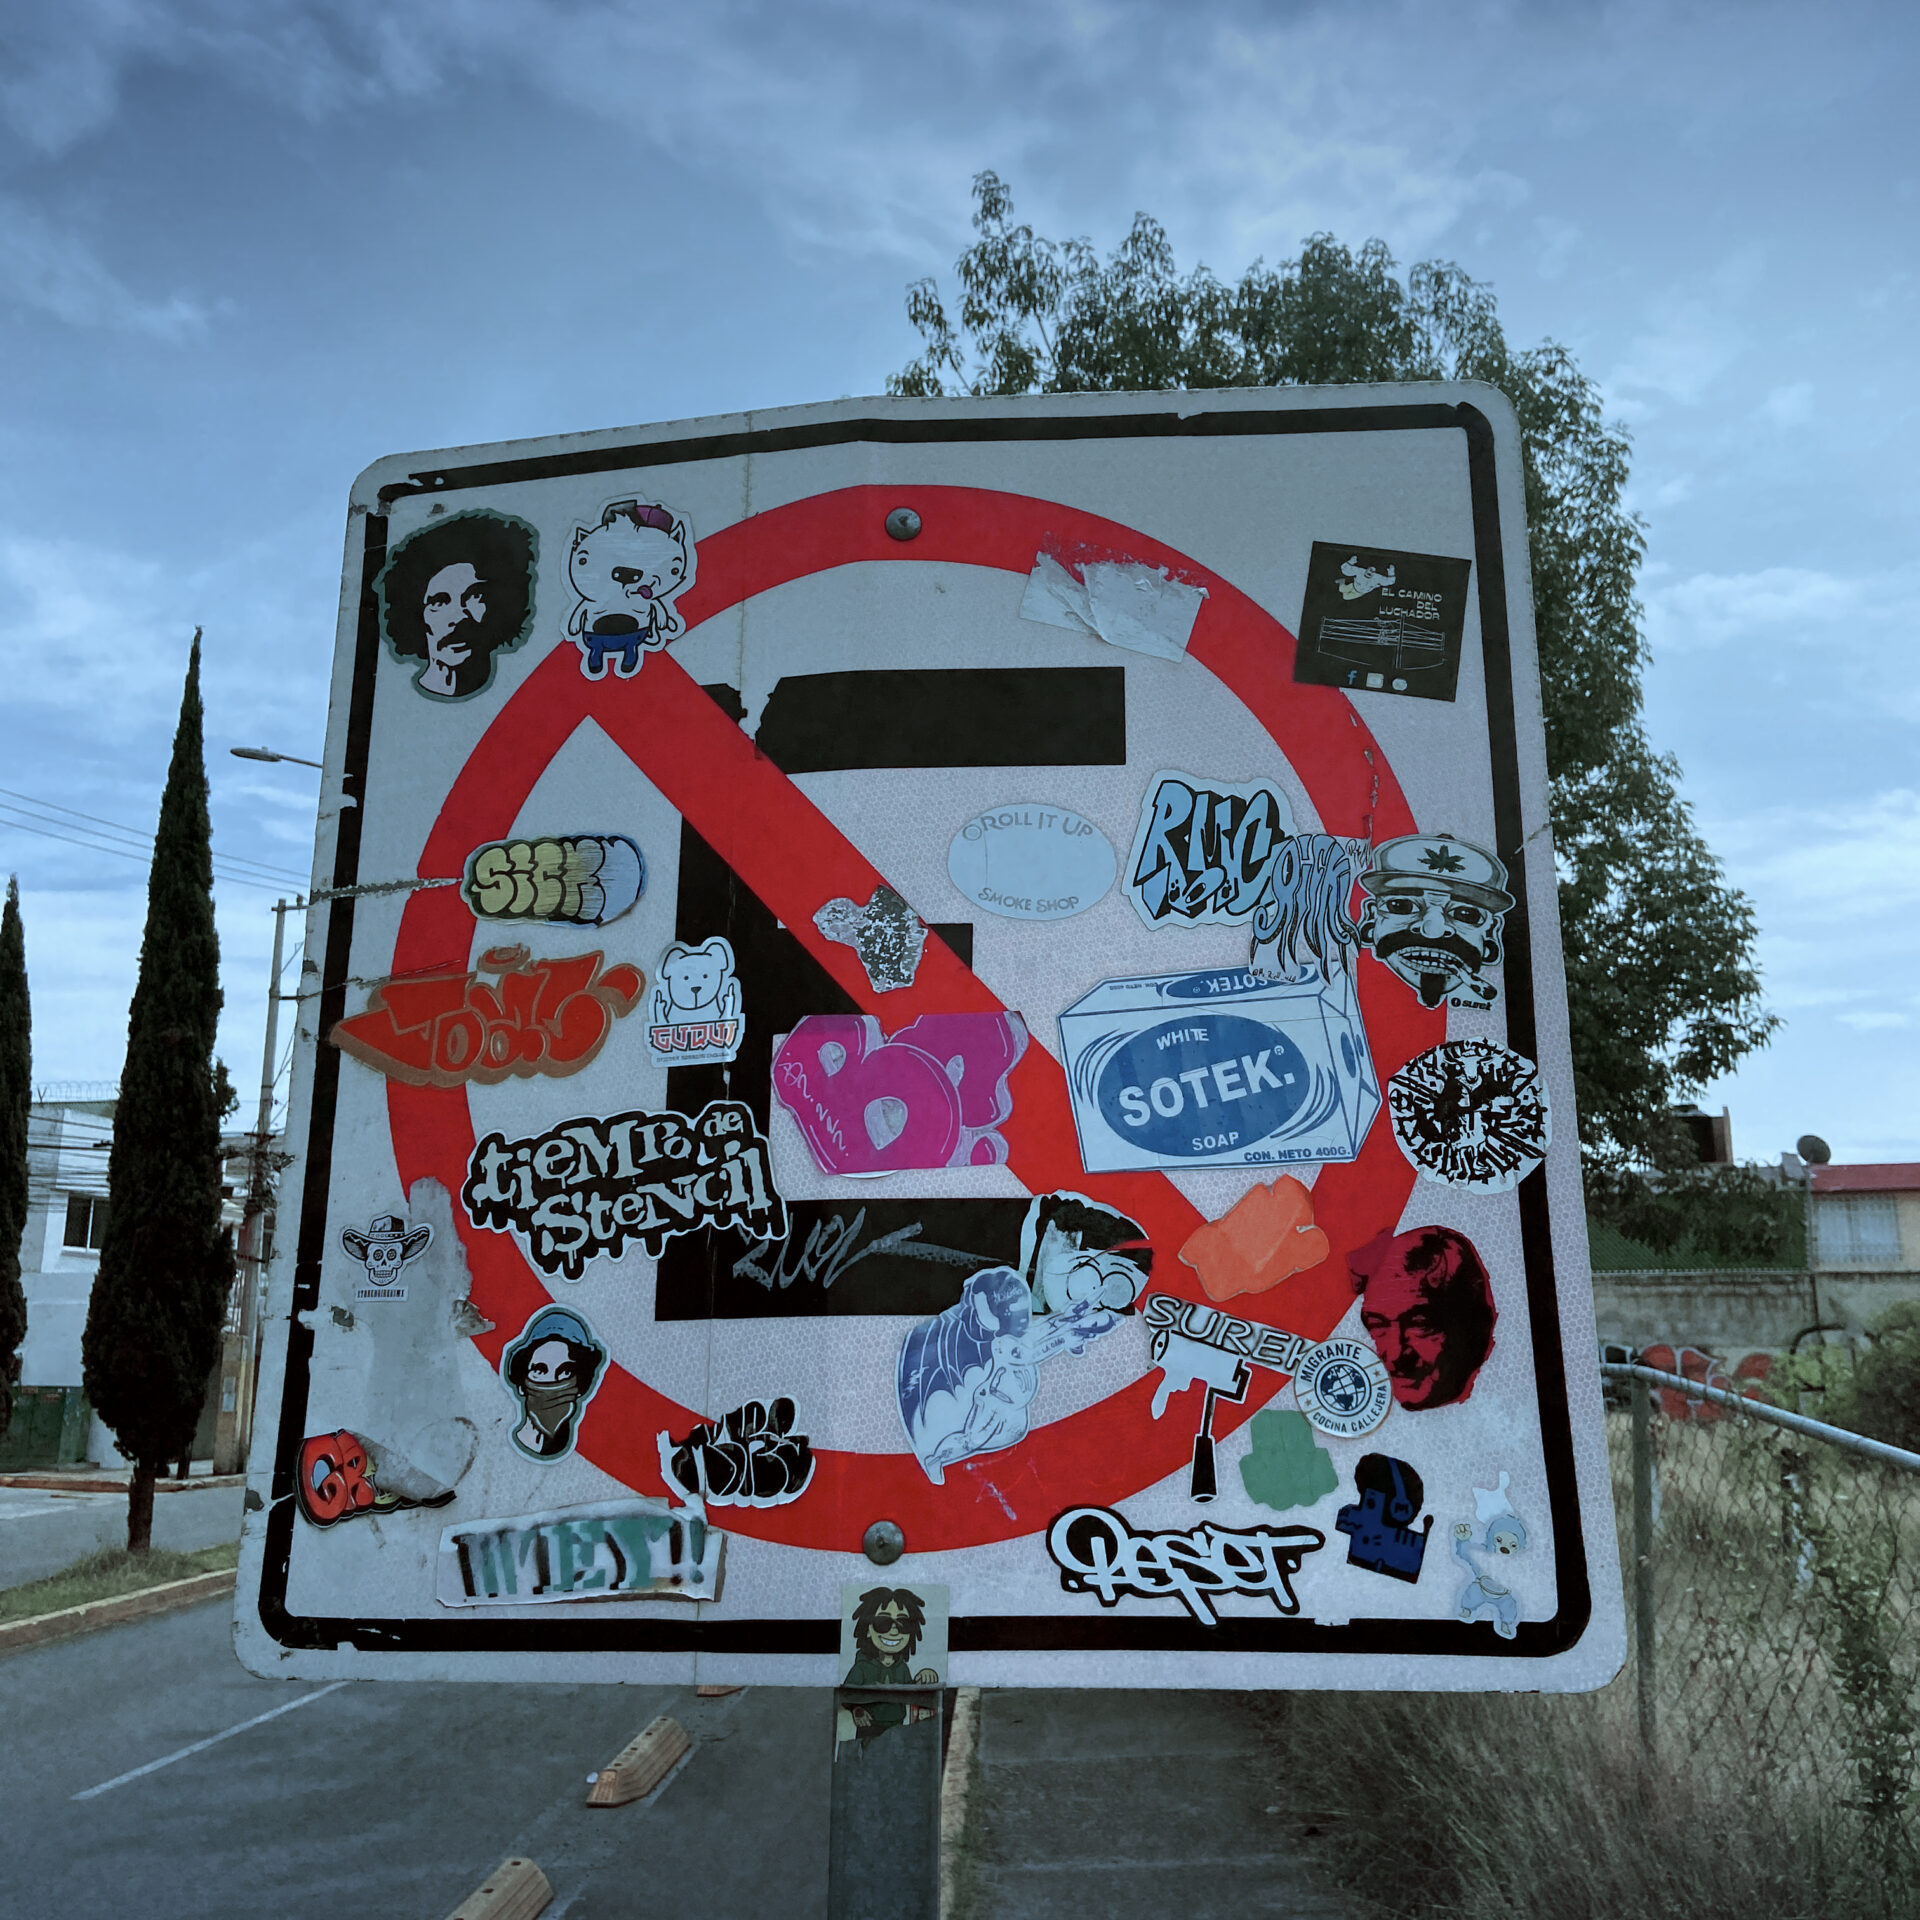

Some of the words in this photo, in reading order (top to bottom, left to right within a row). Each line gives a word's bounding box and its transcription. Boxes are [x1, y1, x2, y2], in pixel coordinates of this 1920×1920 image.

[1381, 587, 1395, 597] EL
[1398, 588, 1443, 603] CAMINO
[1416, 600, 1438, 611] DEL
[1378, 605, 1440, 620] LUCHADOR
[980, 811, 1033, 831] ROLL
[1038, 812, 1058, 830] IT
[1062, 816, 1094, 837] UP
[977, 887, 1032, 911] SMOKE
[1035, 895, 1080, 913] SHOP
[1156, 1027, 1210, 1051] WHITE
[703, 1110, 744, 1138] de
[1191, 1131, 1240, 1151] SOAP
[1243, 1150, 1275, 1162] CON.
[1277, 1148, 1312, 1161] NETO
[1300, 1343, 1362, 1383] MIGRANTE
[1312, 1411, 1348, 1433] COCINA
[1350, 1385, 1387, 1432] CALLEJERA
